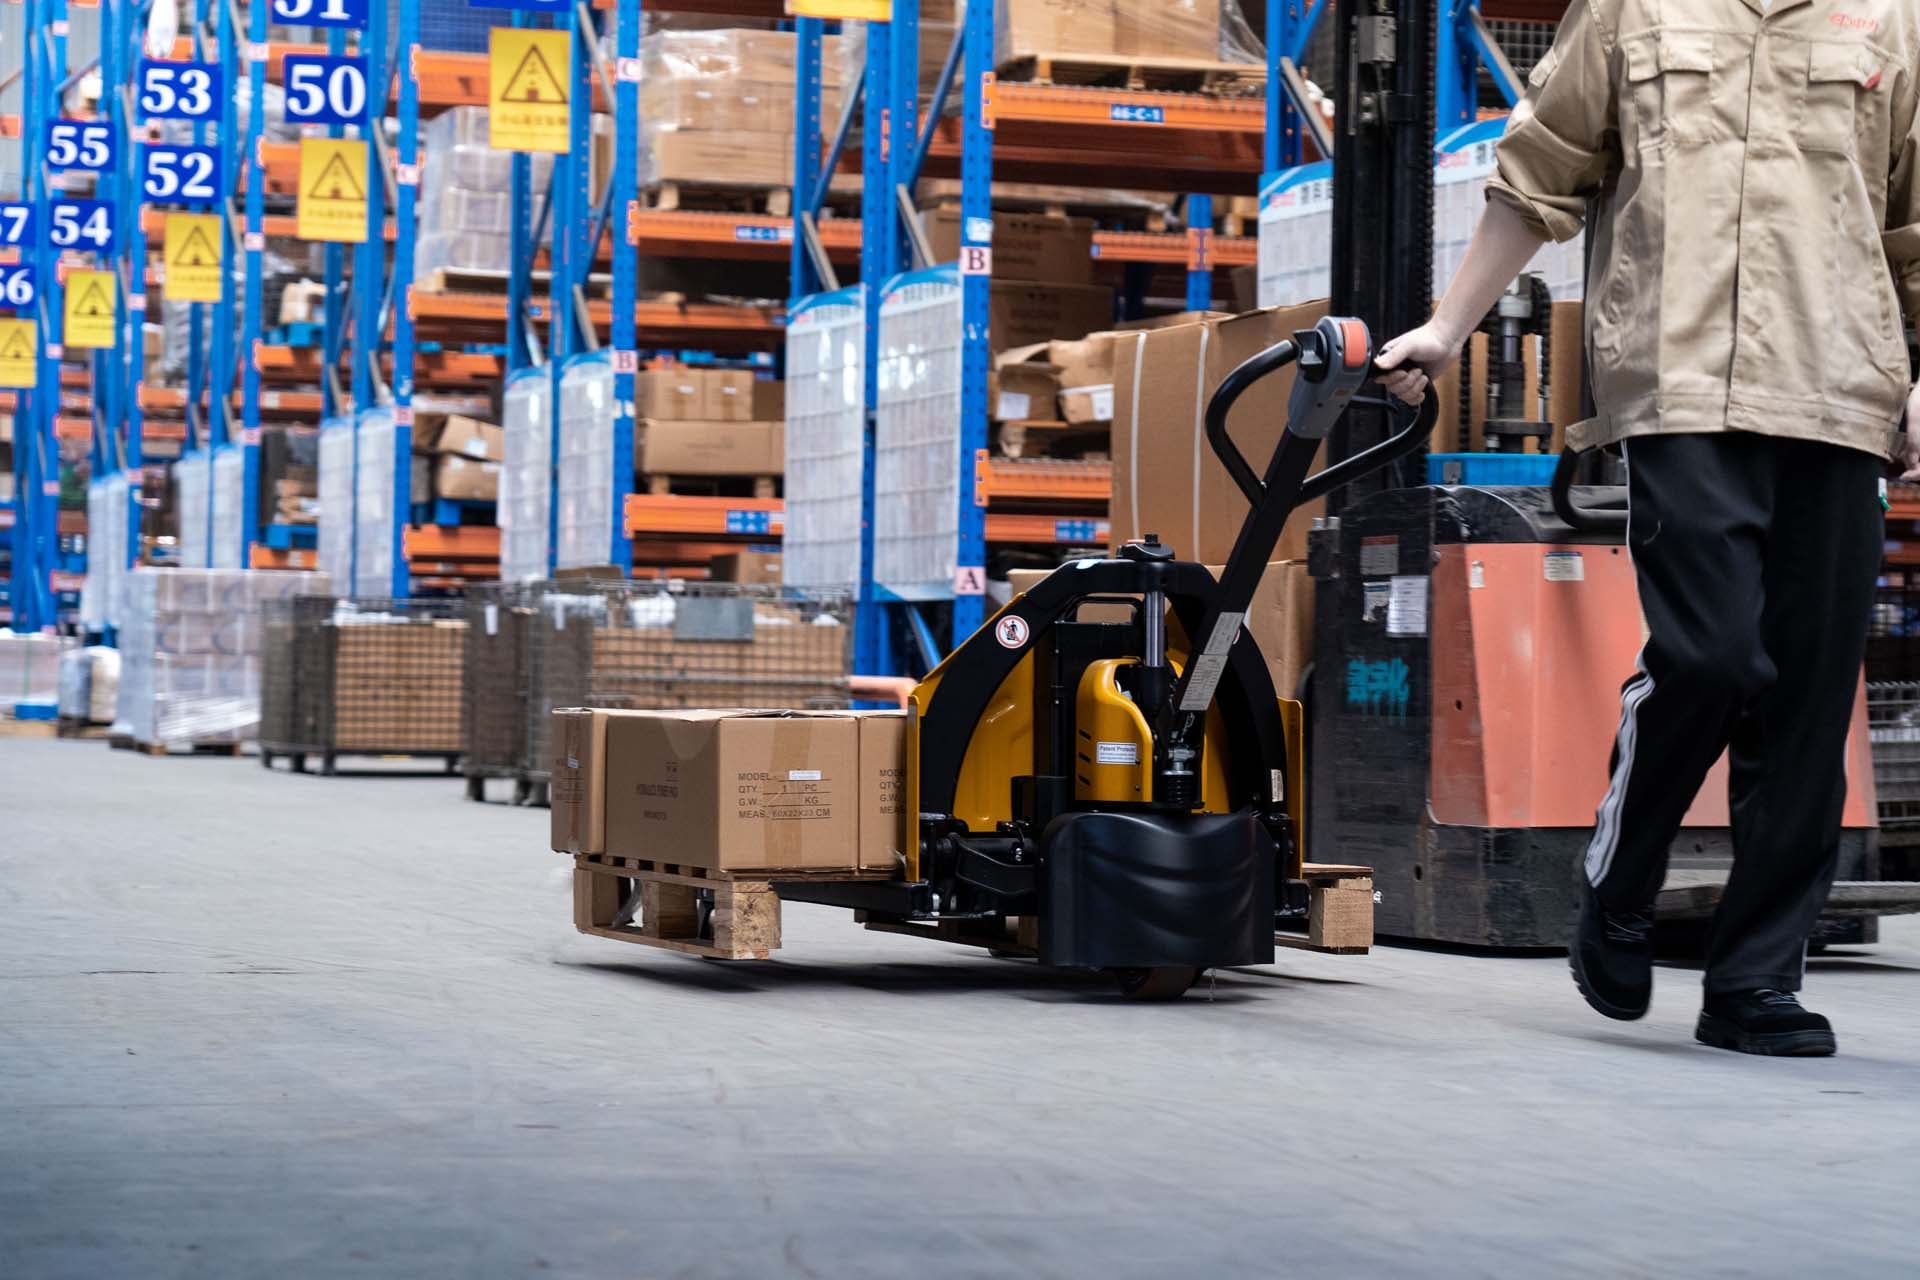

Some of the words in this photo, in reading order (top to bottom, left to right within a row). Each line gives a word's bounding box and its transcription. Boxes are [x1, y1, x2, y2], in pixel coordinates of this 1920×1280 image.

[141, 68, 212, 115] 53
[287, 64, 367, 118] 50
[48, 125, 110, 168] 55
[145, 151, 216, 199] 52
[0, 205, 29, 243] 7
[50, 205, 112, 247] 54
[968, 248, 986, 271] B
[0, 267, 34, 305] 6
[960, 569, 981, 591] A
[804, 783, 817, 792] PC
[804, 796, 819, 805] KG
[815, 807, 831, 817] CM
